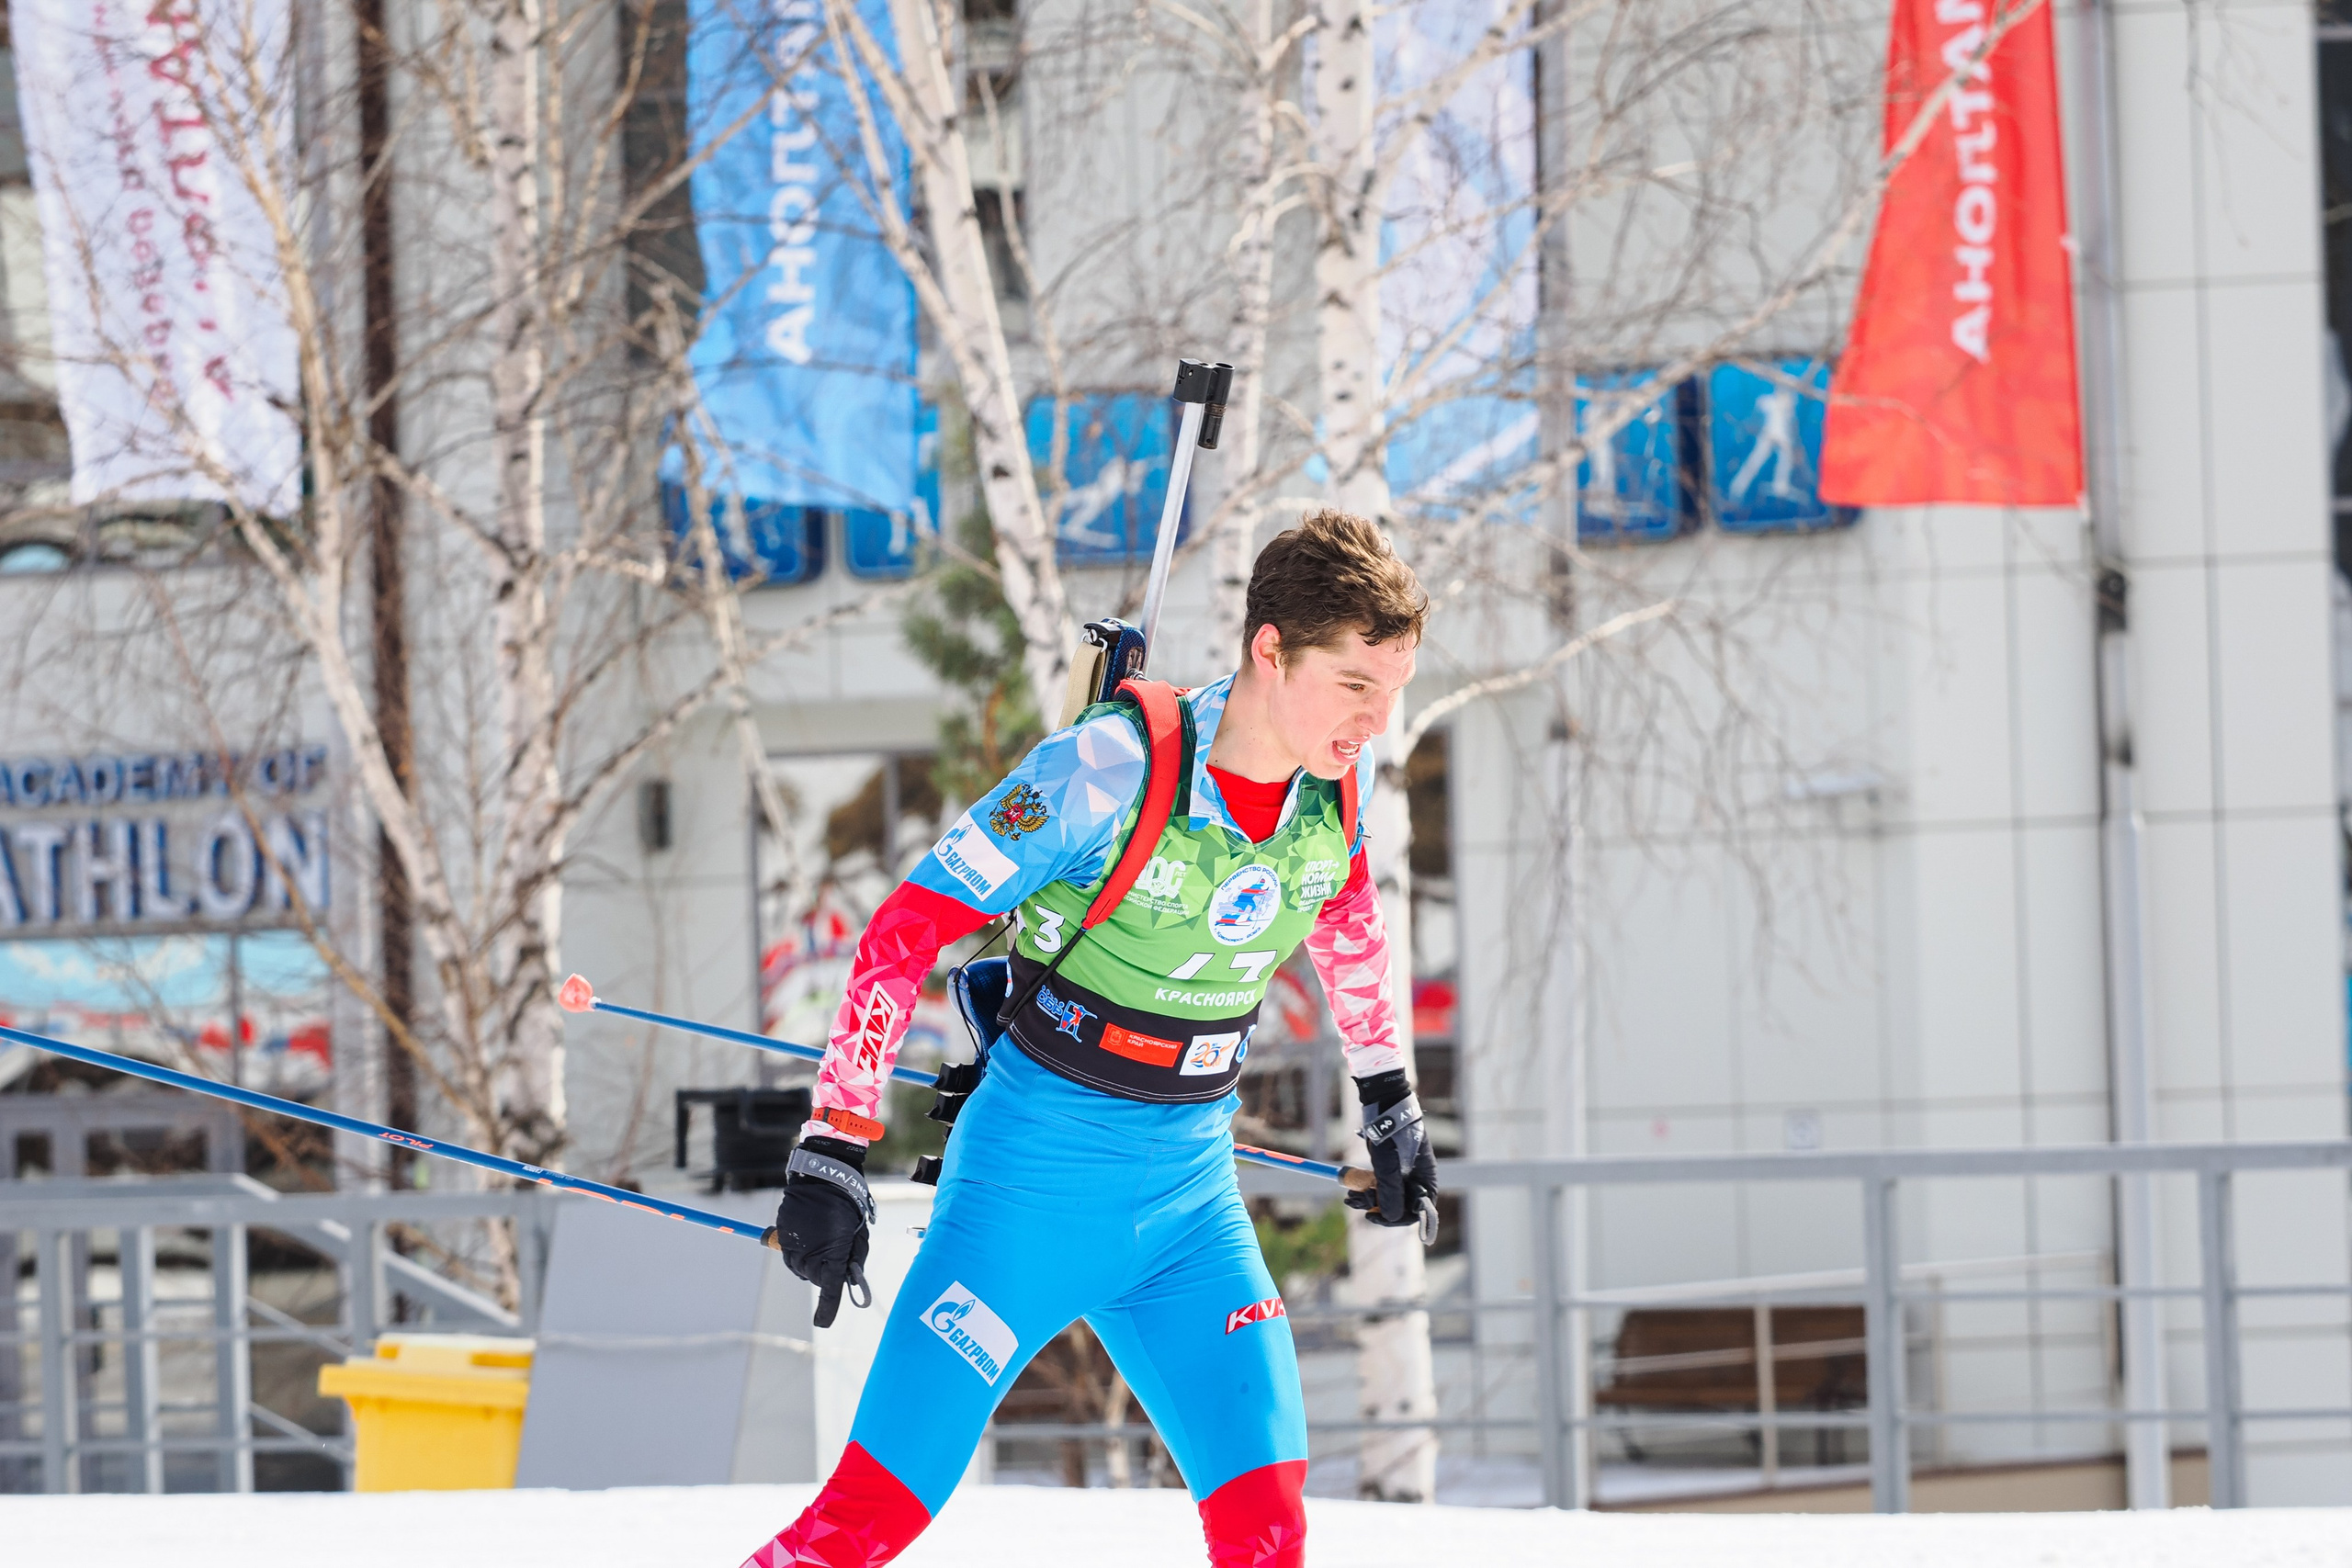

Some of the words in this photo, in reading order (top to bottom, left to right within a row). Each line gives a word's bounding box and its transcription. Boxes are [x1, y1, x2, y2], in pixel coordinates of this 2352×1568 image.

[257, 745, 327, 795] OF
[944, 852, 992, 897] GAZPROM
[1306, 860, 1333, 872] СПОРТ
[1220, 866, 1261, 891] ПЕРВЕНСТВО
[1262, 867, 1278, 887] РОССИИ
[1301, 872, 1336, 886] НОРМА
[1300, 882, 1332, 898] ЖИЗНИ
[1017, 904, 1066, 953] 3
[1155, 987, 1258, 1007] КРАСНОЯРСК
[1127, 1039, 1144, 1047] КРАЙ
[1128, 1034, 1178, 1049] КРАСНОЯРСКИЙ
[378, 1132, 434, 1149] PILOT
[819, 1165, 867, 1198] ONE/WAY
[948, 1328, 1000, 1381] GAZPROM
